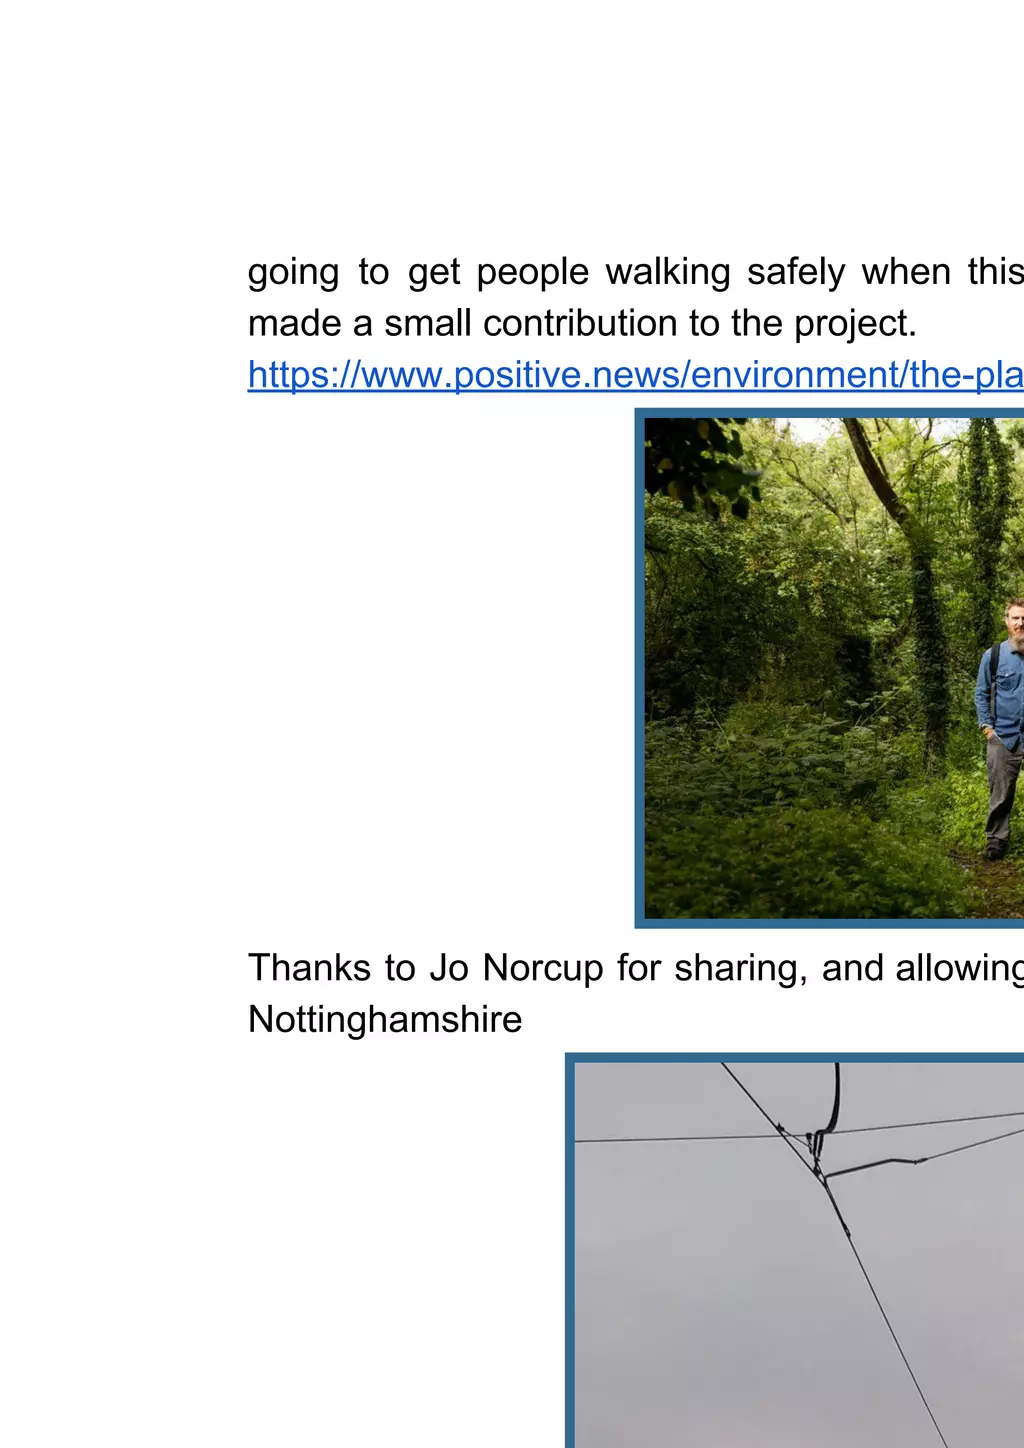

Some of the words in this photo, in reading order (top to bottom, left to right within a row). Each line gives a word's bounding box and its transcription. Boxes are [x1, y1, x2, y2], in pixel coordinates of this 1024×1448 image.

[249, 257, 338, 292] going
[359, 258, 389, 285] to
[409, 258, 460, 292] get
[479, 256, 588, 292] people
[606, 256, 729, 292] walking
[748, 256, 845, 292] safely
[862, 257, 950, 285] when
[968, 257, 1024, 285] this
[250, 308, 341, 336] made
[354, 315, 372, 336] a
[385, 308, 470, 336] small
[484, 308, 676, 336] contribution
[689, 309, 719, 336] to
[731, 308, 782, 336] the
[796, 308, 915, 344] project.
[248, 953, 370, 981] Thanks
[385, 954, 415, 981] to
[430, 953, 468, 981] Jo
[485, 953, 603, 988] Norcup
[617, 953, 662, 981] for
[676, 953, 806, 988] sharing,
[823, 953, 882, 981] and
[250, 1005, 521, 1040] Nottinghamshire
